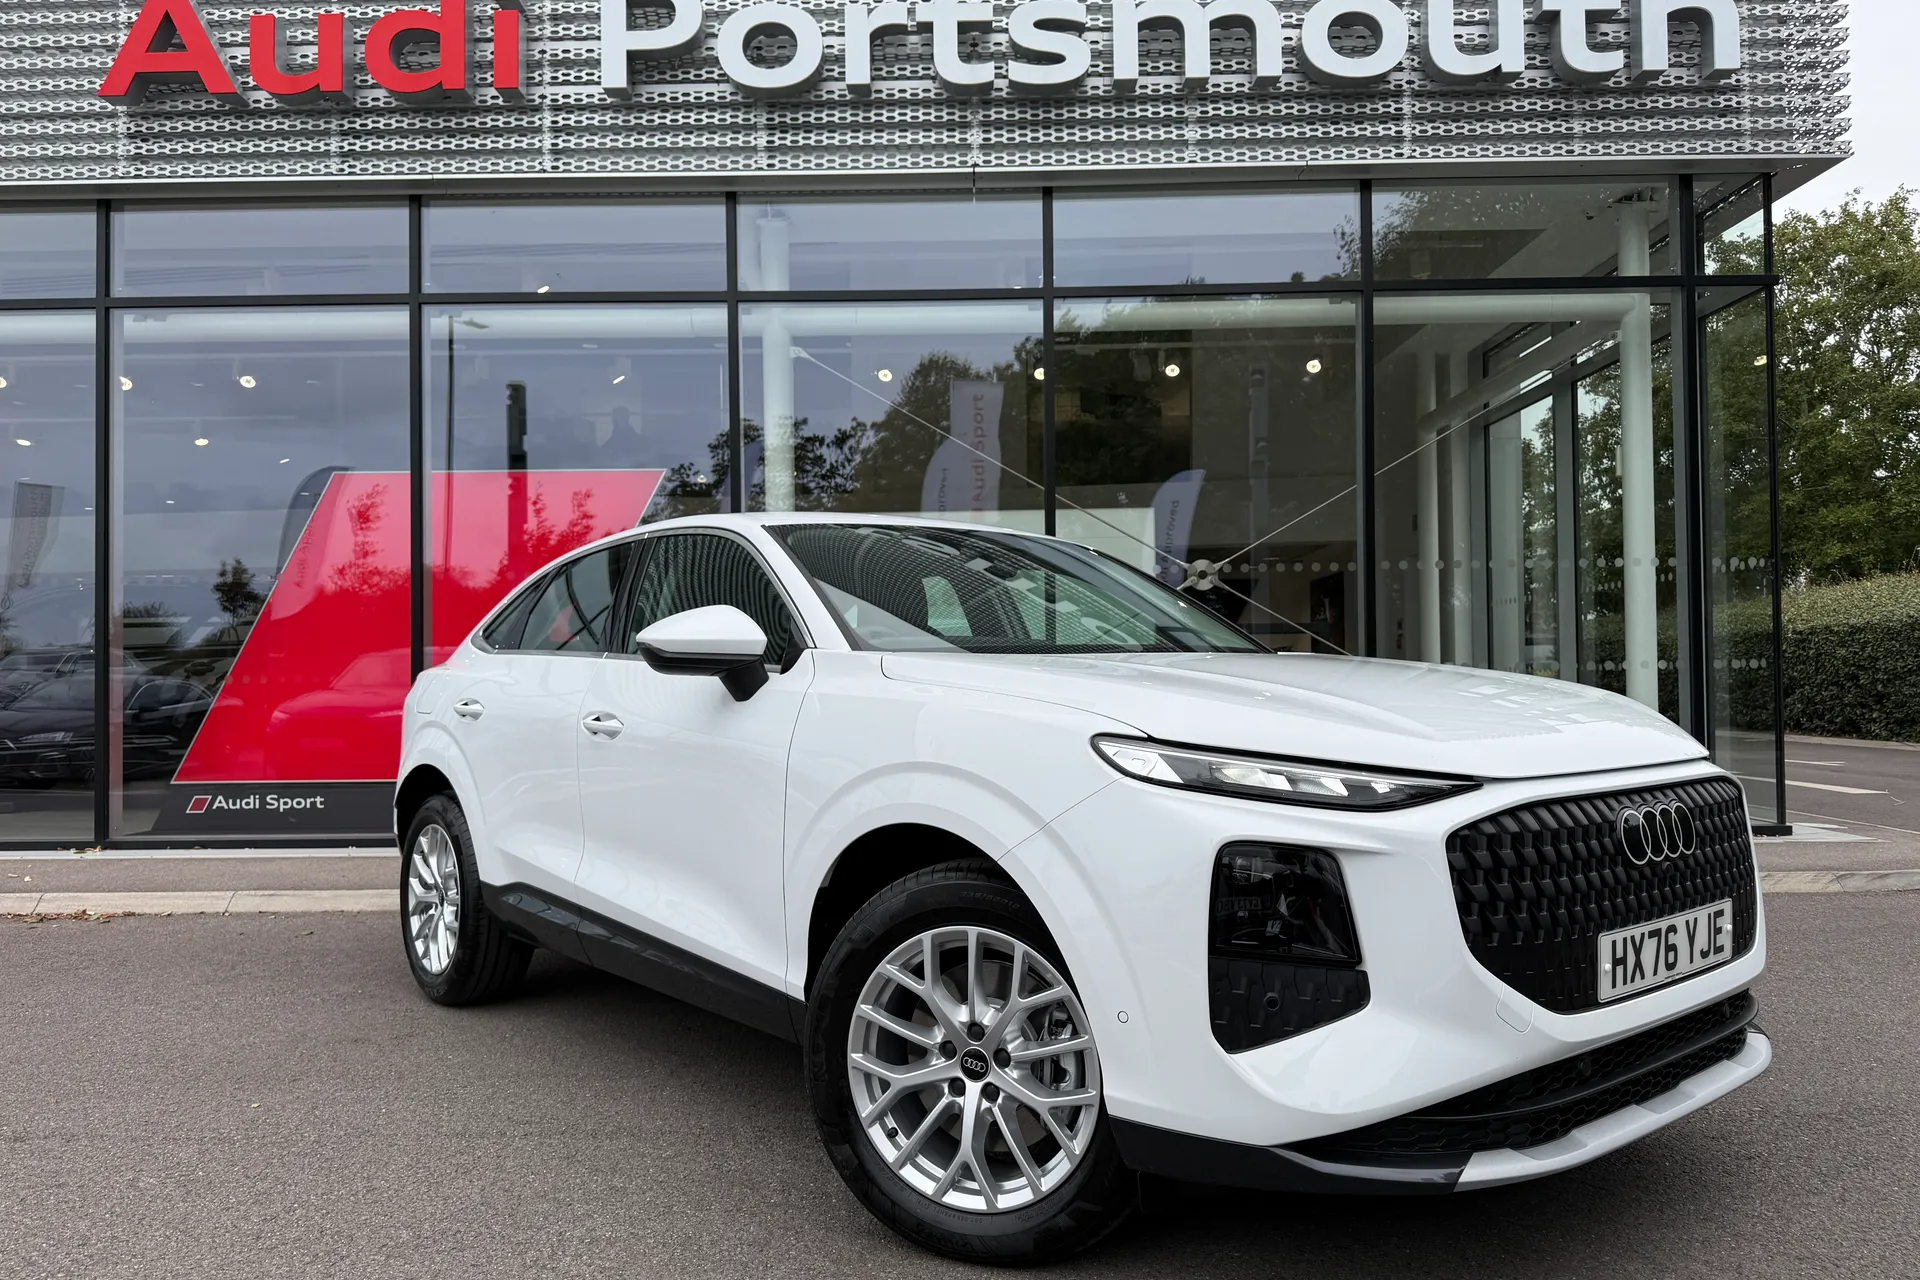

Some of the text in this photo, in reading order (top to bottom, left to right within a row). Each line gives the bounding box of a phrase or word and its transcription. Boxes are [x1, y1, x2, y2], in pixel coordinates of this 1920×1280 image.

[98, 0, 1740, 97] Audi Portsmouth
[212, 794, 325, 812] Audi Sport
[1611, 908, 1725, 989] HX76 YJE
